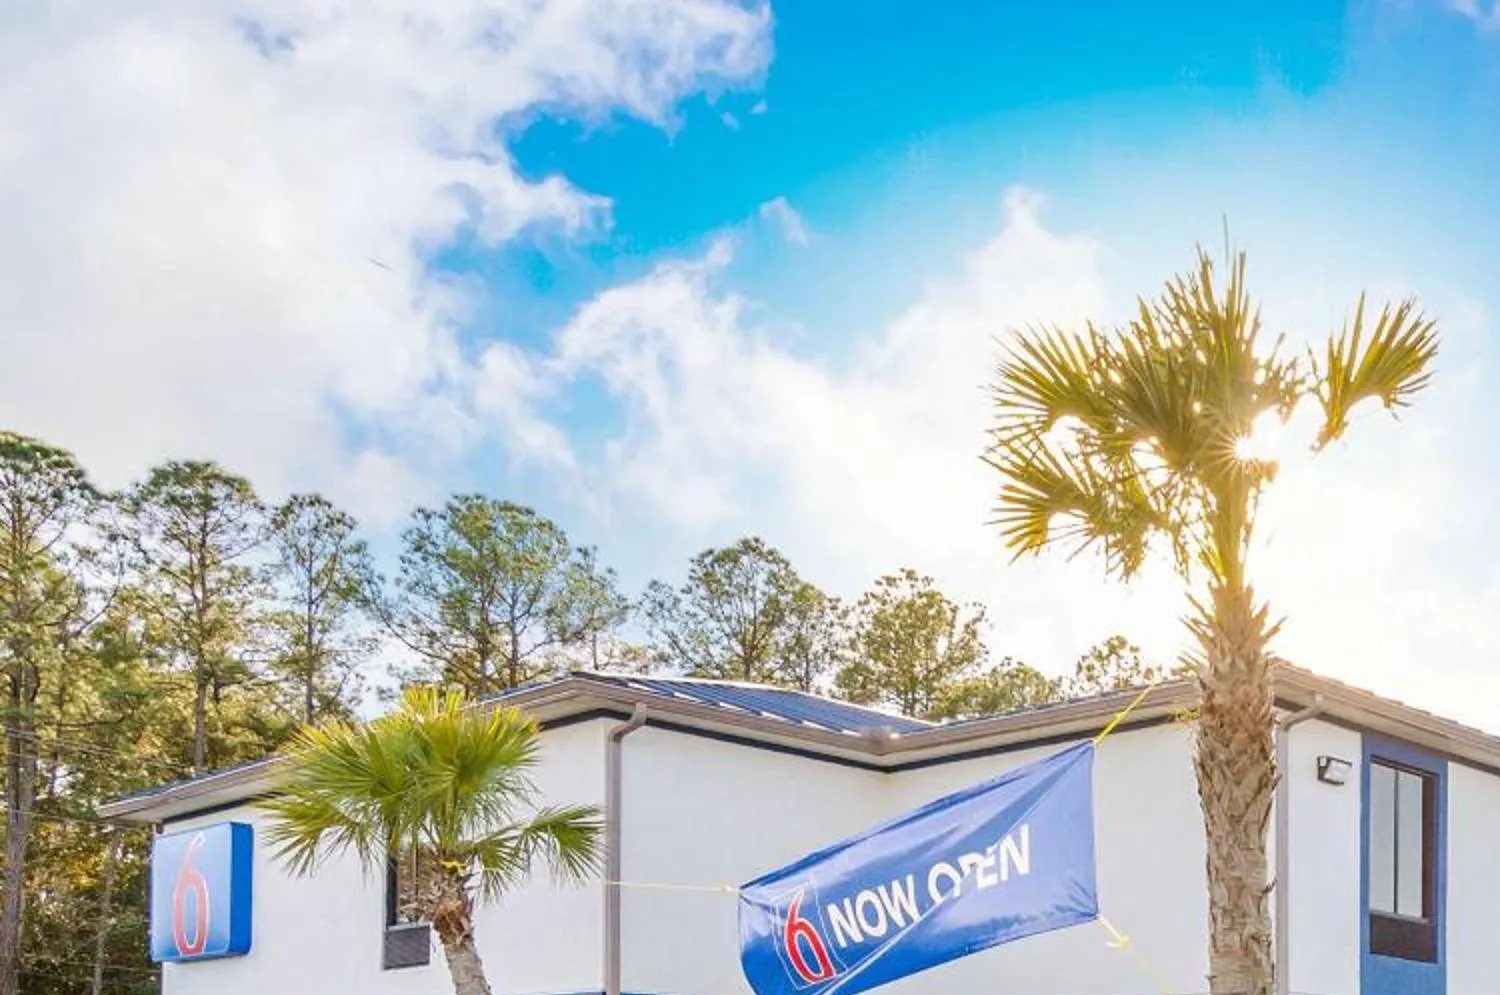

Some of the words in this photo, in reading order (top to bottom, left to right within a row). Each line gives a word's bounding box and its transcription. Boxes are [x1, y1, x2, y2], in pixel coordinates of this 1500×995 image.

[173, 831, 209, 957] 6
[782, 884, 835, 985] 6
[828, 873, 921, 949] NOW
[927, 823, 1031, 906] OPEN
